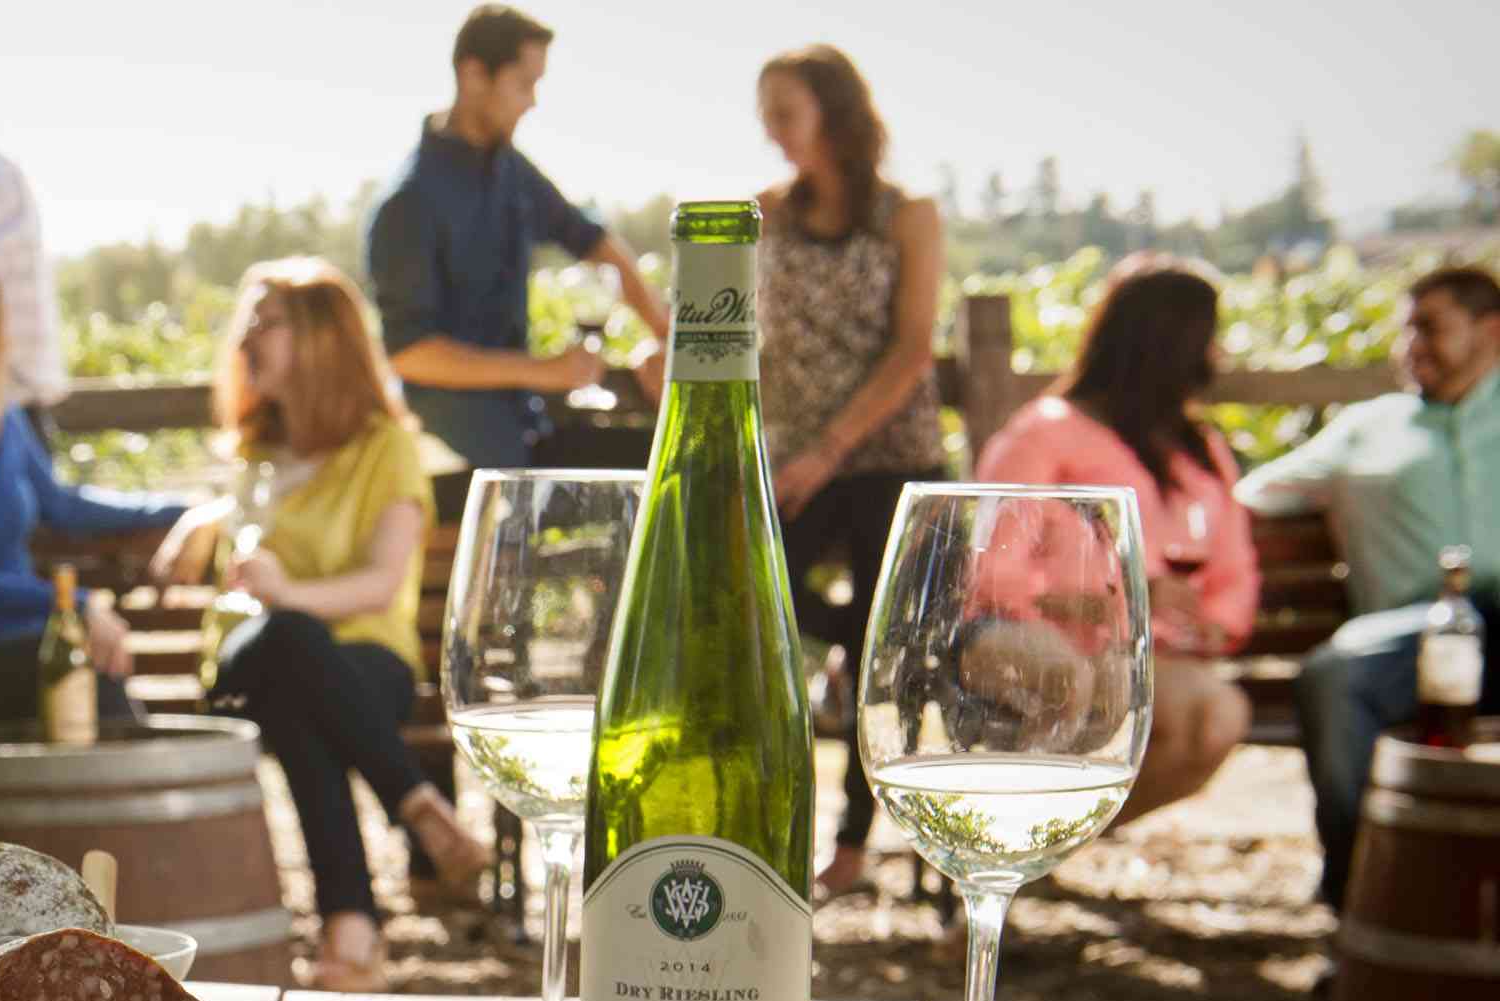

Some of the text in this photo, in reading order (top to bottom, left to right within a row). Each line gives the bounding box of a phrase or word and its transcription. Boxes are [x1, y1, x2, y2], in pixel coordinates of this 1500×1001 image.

[660, 961, 710, 973] 2014
[615, 981, 760, 1001] DRY RIESLING
